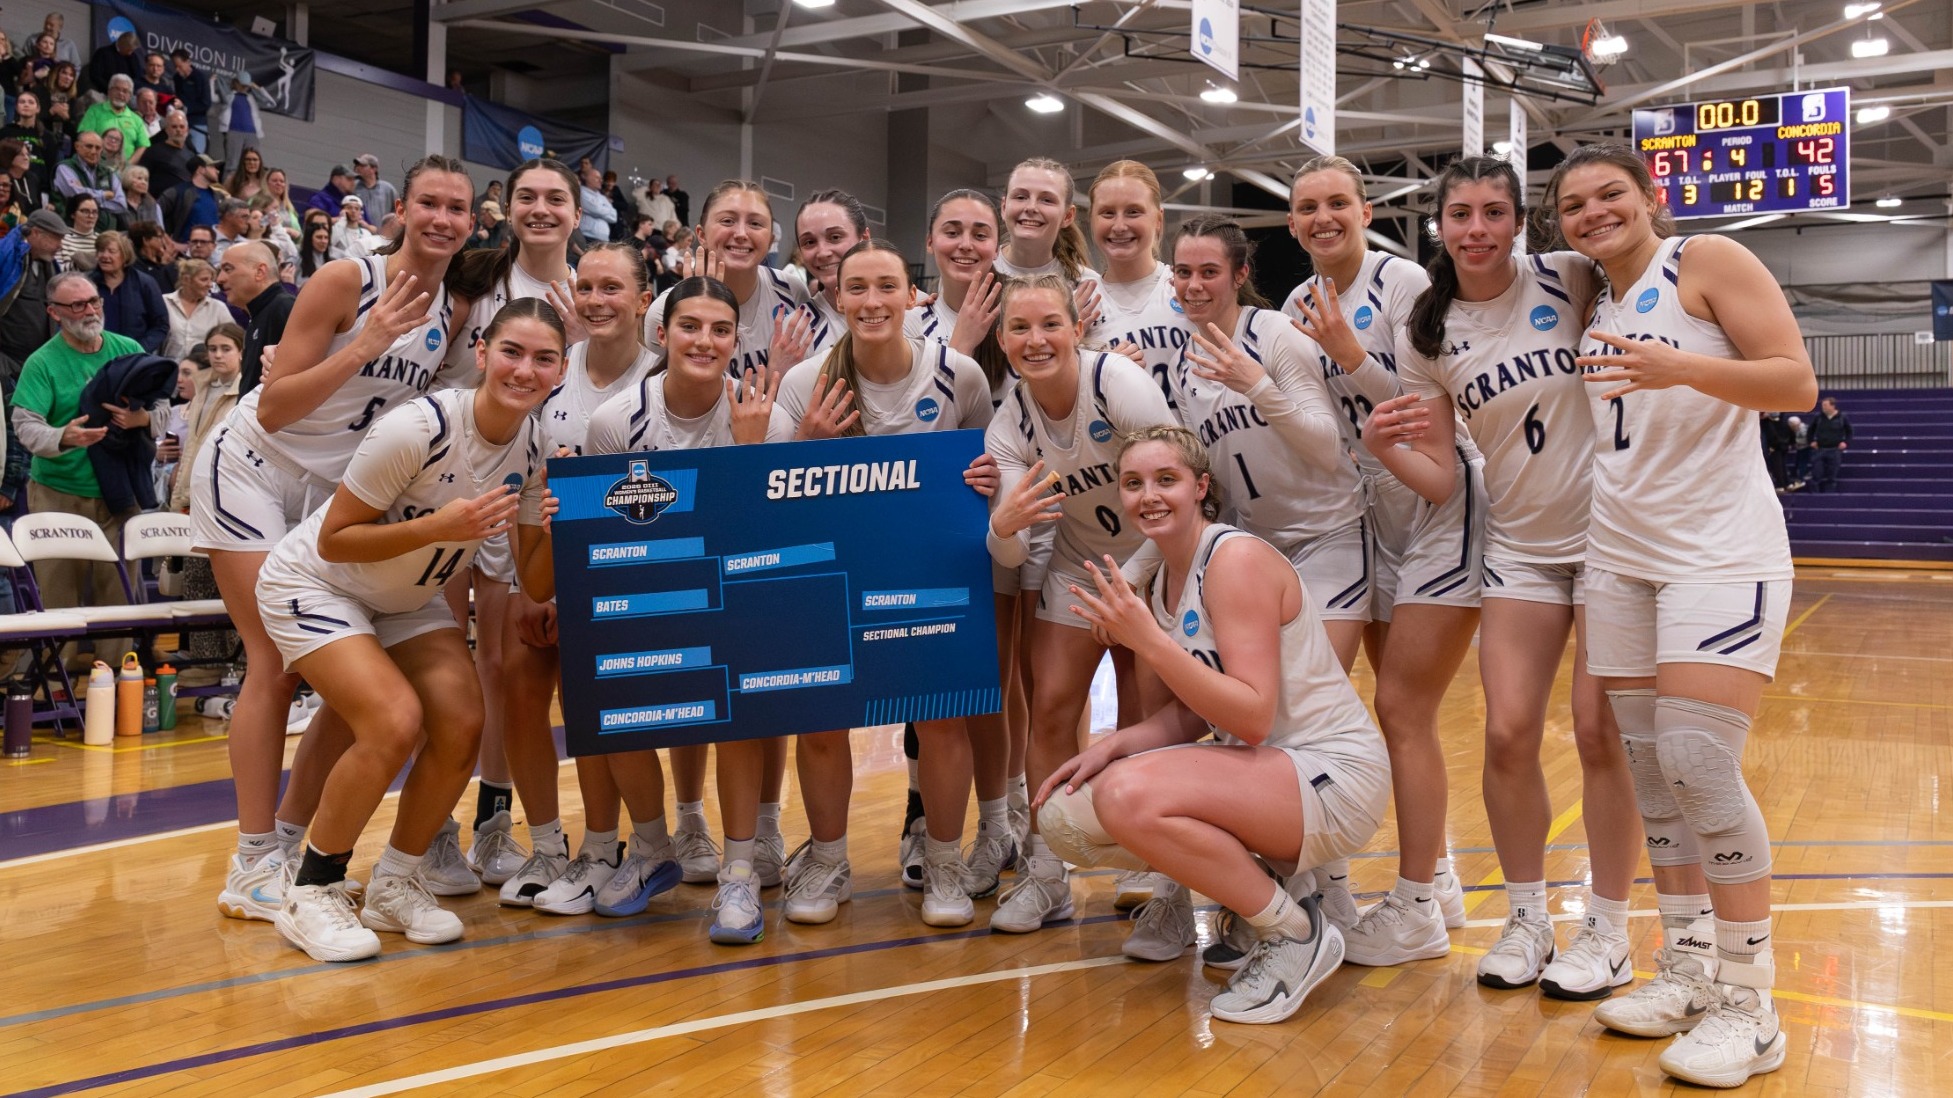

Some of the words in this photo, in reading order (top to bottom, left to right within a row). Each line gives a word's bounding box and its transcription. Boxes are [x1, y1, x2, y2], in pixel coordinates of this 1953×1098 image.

[232, 55, 245, 71] III
[1700, 99, 1759, 130] 00.0
[1777, 121, 1841, 139] CONCORDIA
[1641, 134, 1696, 150] SCRANTON
[1721, 136, 1753, 146] PERIOD
[1730, 149, 1746, 167] 4
[1798, 138, 1834, 163] 42
[1654, 150, 1688, 176] 67
[1808, 164, 1837, 175] FOULS
[1709, 173, 1740, 183] PLAYER
[1745, 170, 1767, 180] FOUL
[1775, 168, 1799, 179] T.O.L.
[1819, 174, 1834, 195] 5
[1683, 184, 1698, 205] 3
[1809, 197, 1838, 208] SCORE
[1723, 203, 1753, 213] MATCH
[1535, 314, 1557, 326] NCAA
[359, 355, 433, 392] RANTO
[348, 396, 387, 432] 5
[919, 406, 938, 417] NCAA
[1523, 402, 1546, 455] 6
[1609, 396, 1630, 451] 2
[766, 459, 921, 500] SECTIONAL
[1232, 452, 1261, 500] 1
[606, 492, 676, 506] CHAMPIONSHIP
[1095, 505, 1121, 537] 0
[29, 527, 93, 540] SCRANTON
[140, 526, 191, 540] SCRANTO
[592, 545, 648, 561] SCRANTON
[727, 553, 781, 571] SCRANTON
[414, 548, 465, 586] 14
[596, 599, 629, 613] BATES
[865, 594, 917, 607] SCRANTON
[863, 627, 909, 641] SECTIONAL
[911, 623, 956, 636] CHAMPION
[599, 657, 635, 671] JOHNS
[637, 653, 683, 668] HOPKINS
[742, 669, 840, 689] CONCORDIA-M'HEAD
[603, 705, 704, 726] CONCORDIA-M'HEAD
